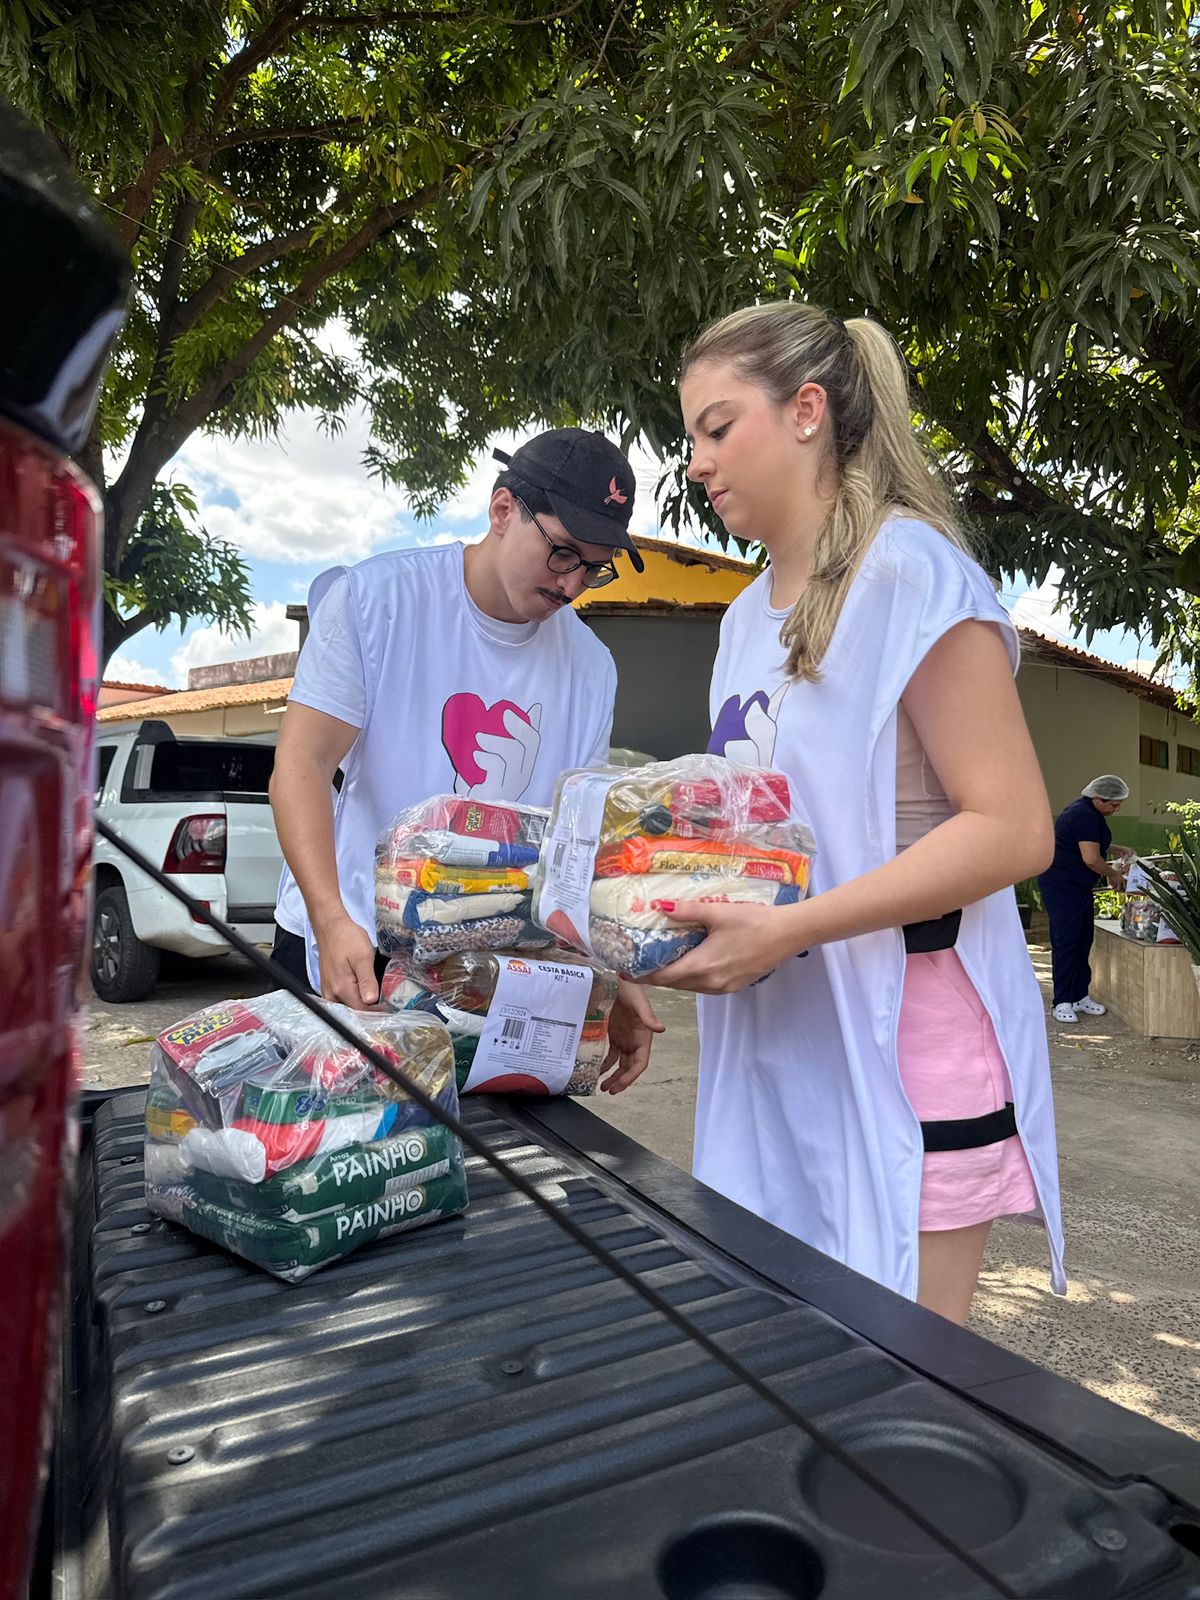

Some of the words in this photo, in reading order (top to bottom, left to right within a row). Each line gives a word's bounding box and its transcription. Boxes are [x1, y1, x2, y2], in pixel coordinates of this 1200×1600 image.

[538, 965, 560, 974] CESTA
[560, 967, 586, 979] BÁSICA
[329, 1152, 351, 1163] Arroz
[332, 1139, 424, 1187] PAINHO
[336, 1190, 424, 1241] PAINHO
